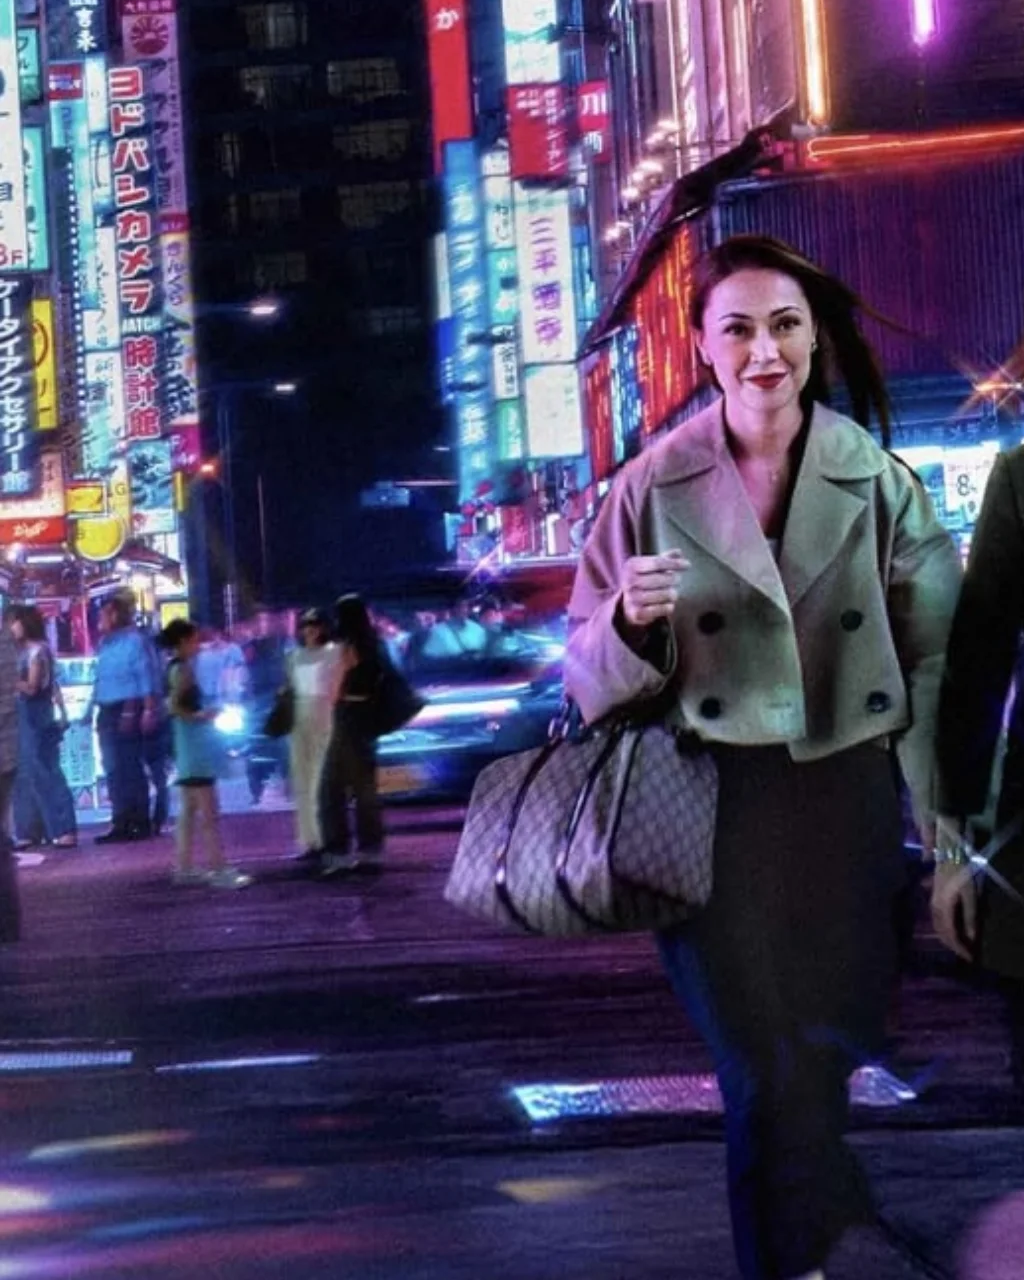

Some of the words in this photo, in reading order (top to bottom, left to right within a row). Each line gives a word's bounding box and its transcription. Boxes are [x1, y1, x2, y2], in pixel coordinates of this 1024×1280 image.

[108, 66, 151, 313] ヨドバシカメラ
